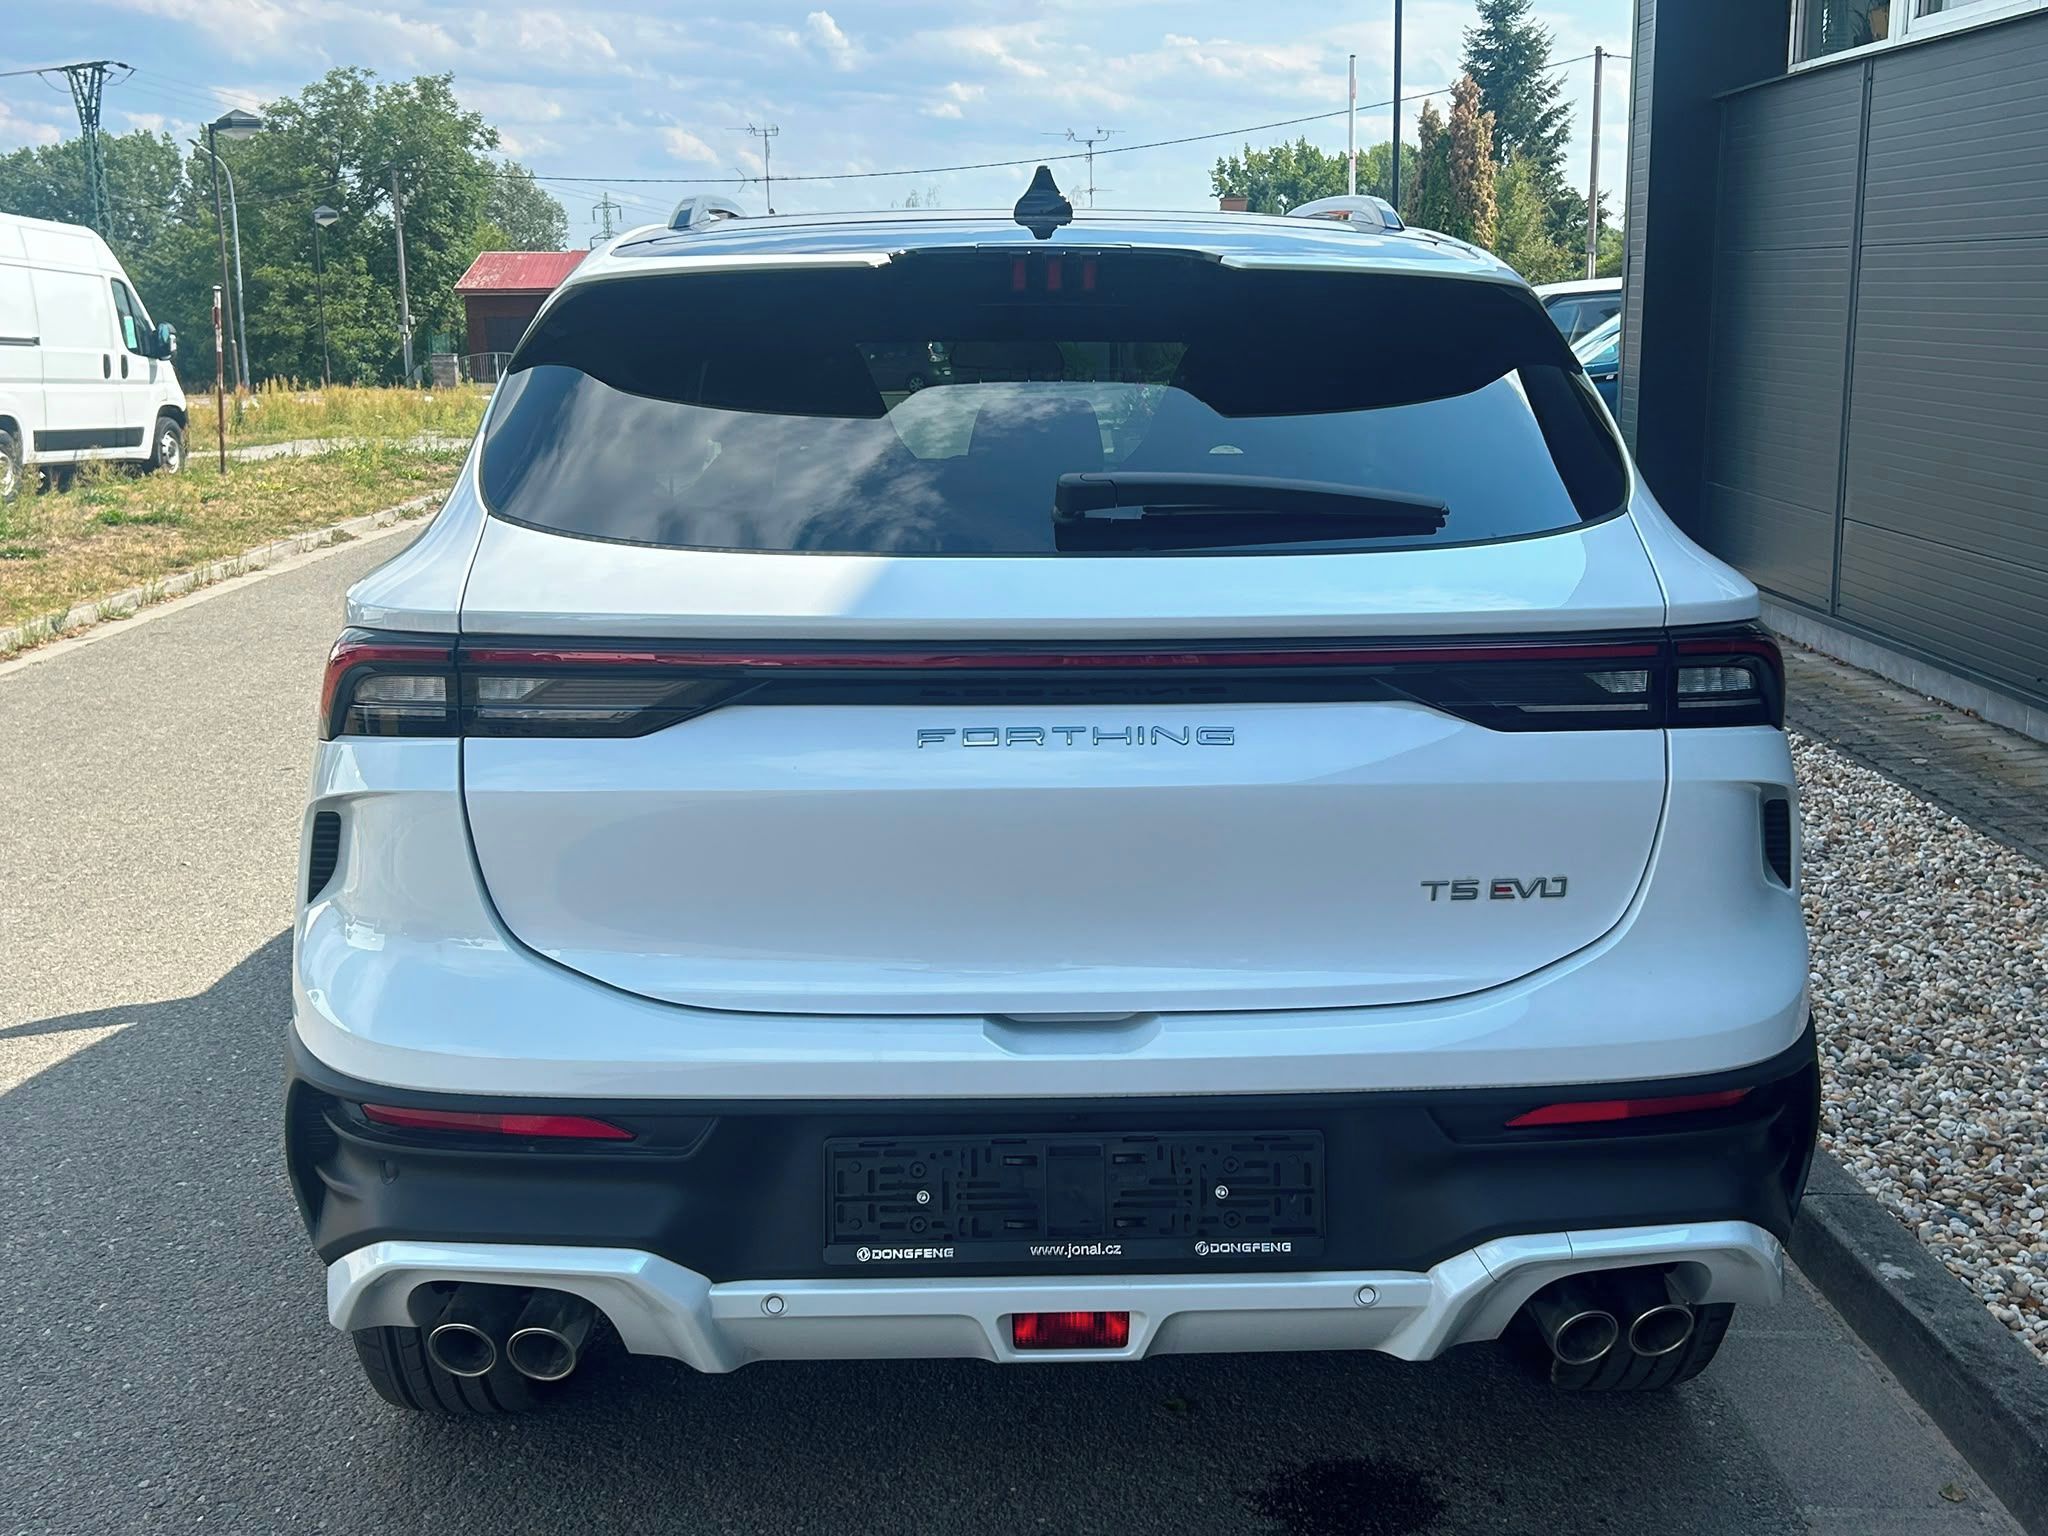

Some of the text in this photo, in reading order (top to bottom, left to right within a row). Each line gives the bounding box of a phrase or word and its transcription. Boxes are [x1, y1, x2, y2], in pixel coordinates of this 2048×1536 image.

[916, 726, 1235, 748] FORTHING
[1420, 876, 1568, 901] T5 EVO
[871, 1247, 955, 1260] DONGFENG
[1029, 1242, 1122, 1259] www.jonal.cz
[1209, 1242, 1292, 1254] DONGFENG
